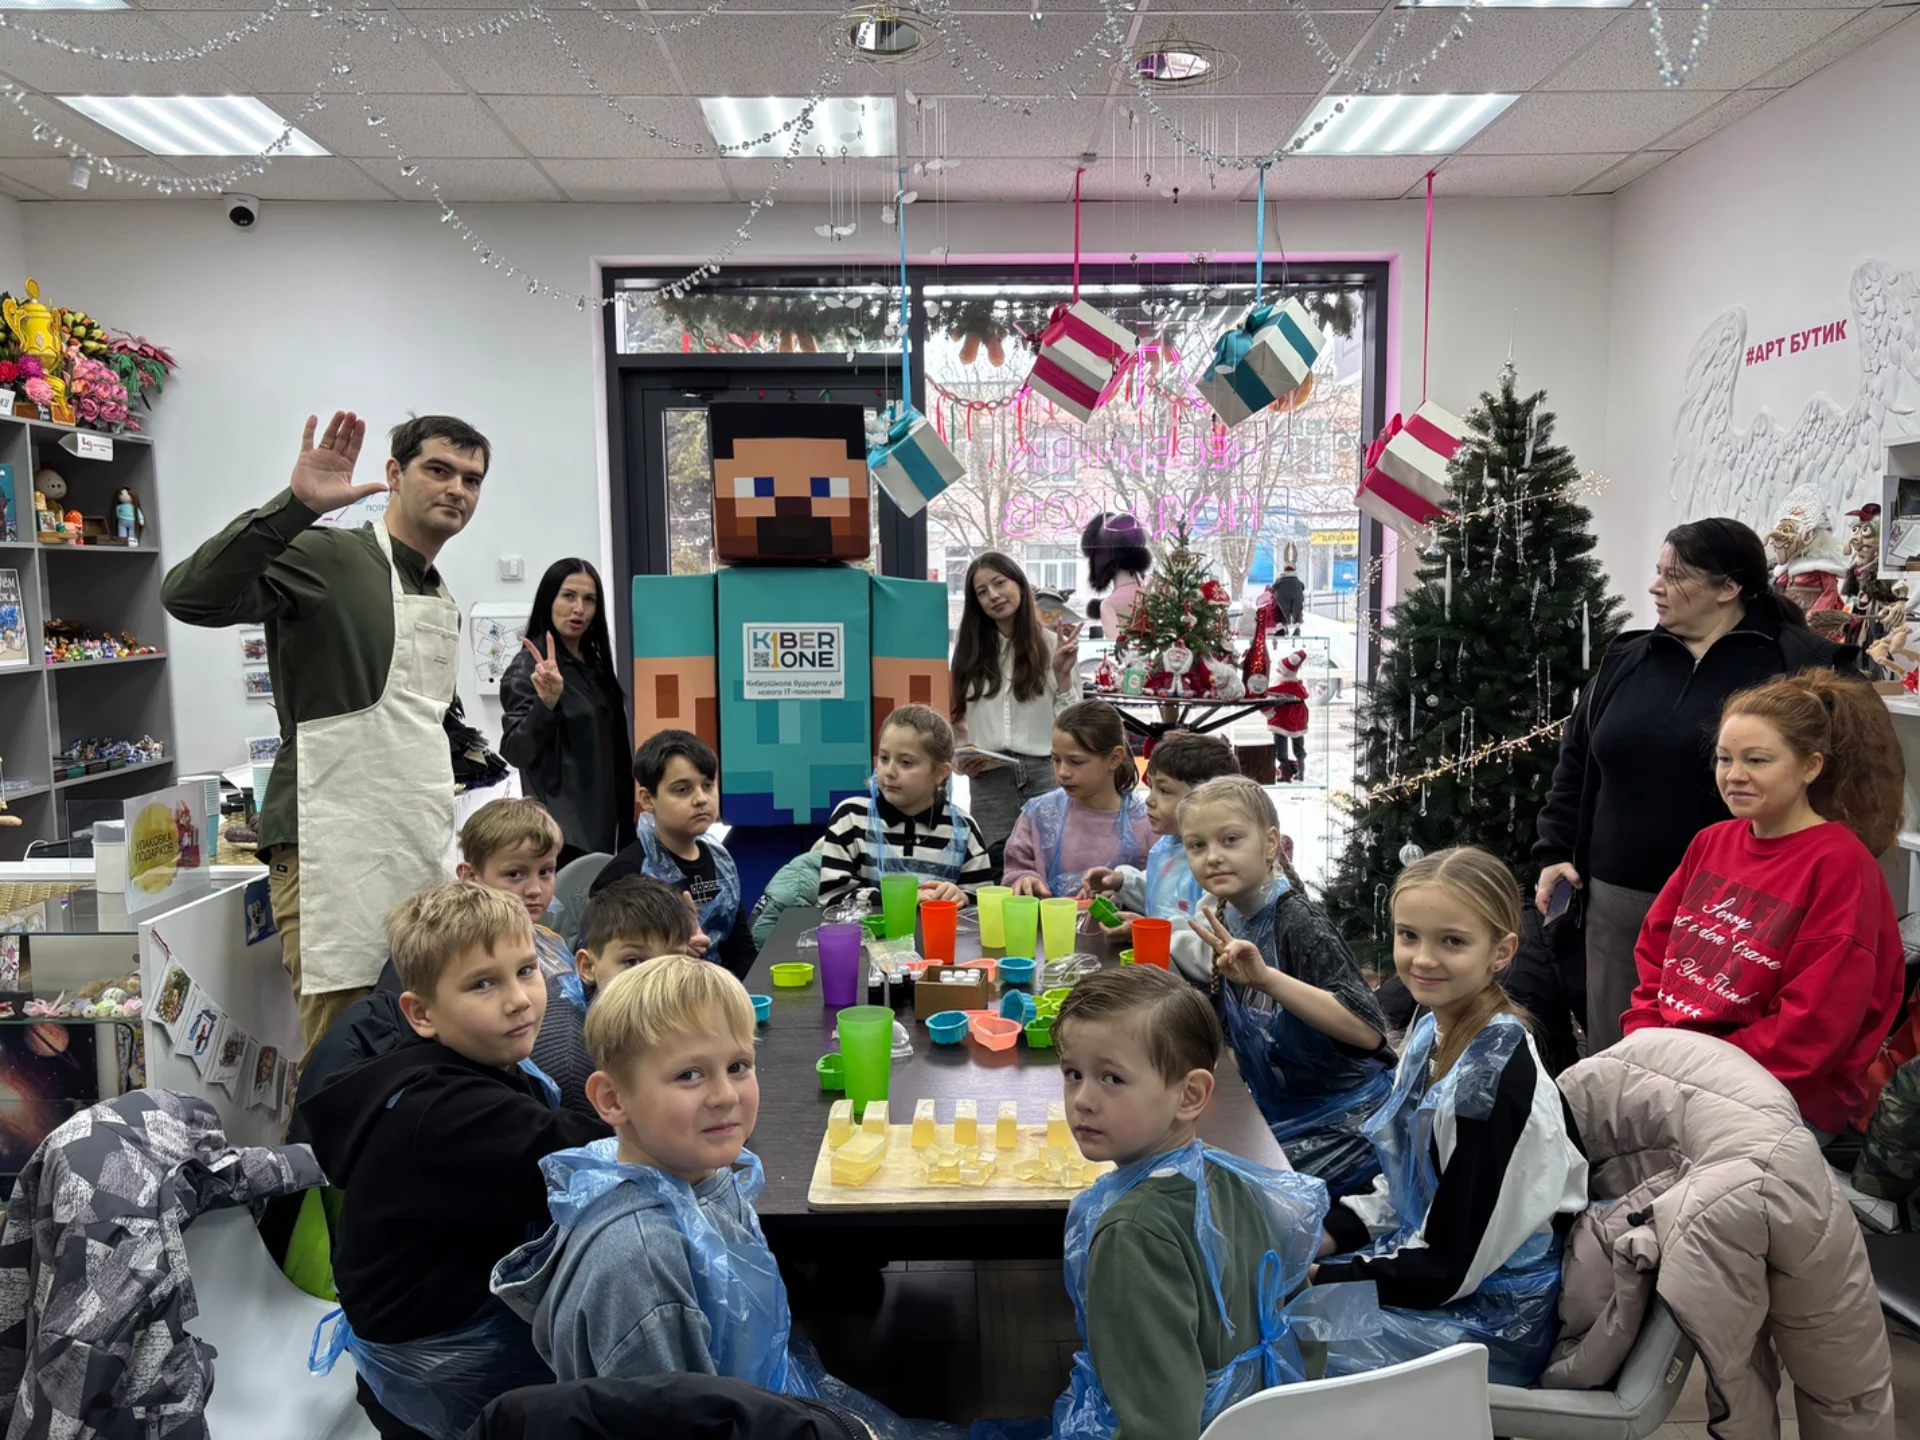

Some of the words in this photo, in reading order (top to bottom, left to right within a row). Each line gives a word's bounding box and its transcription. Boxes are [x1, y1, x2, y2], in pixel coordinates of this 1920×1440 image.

[1746, 337, 1786, 367] #АРТ
[1790, 319, 1847, 354] БУТИК
[780, 651, 834, 668] ONE
[134, 842, 174, 864] ПОДАРКОВ
[135, 832, 173, 853] УПАКОВКА
[1702, 897, 1752, 934] Sorry
[1676, 957, 1703, 985] You
[1707, 972, 1760, 1005] Think
